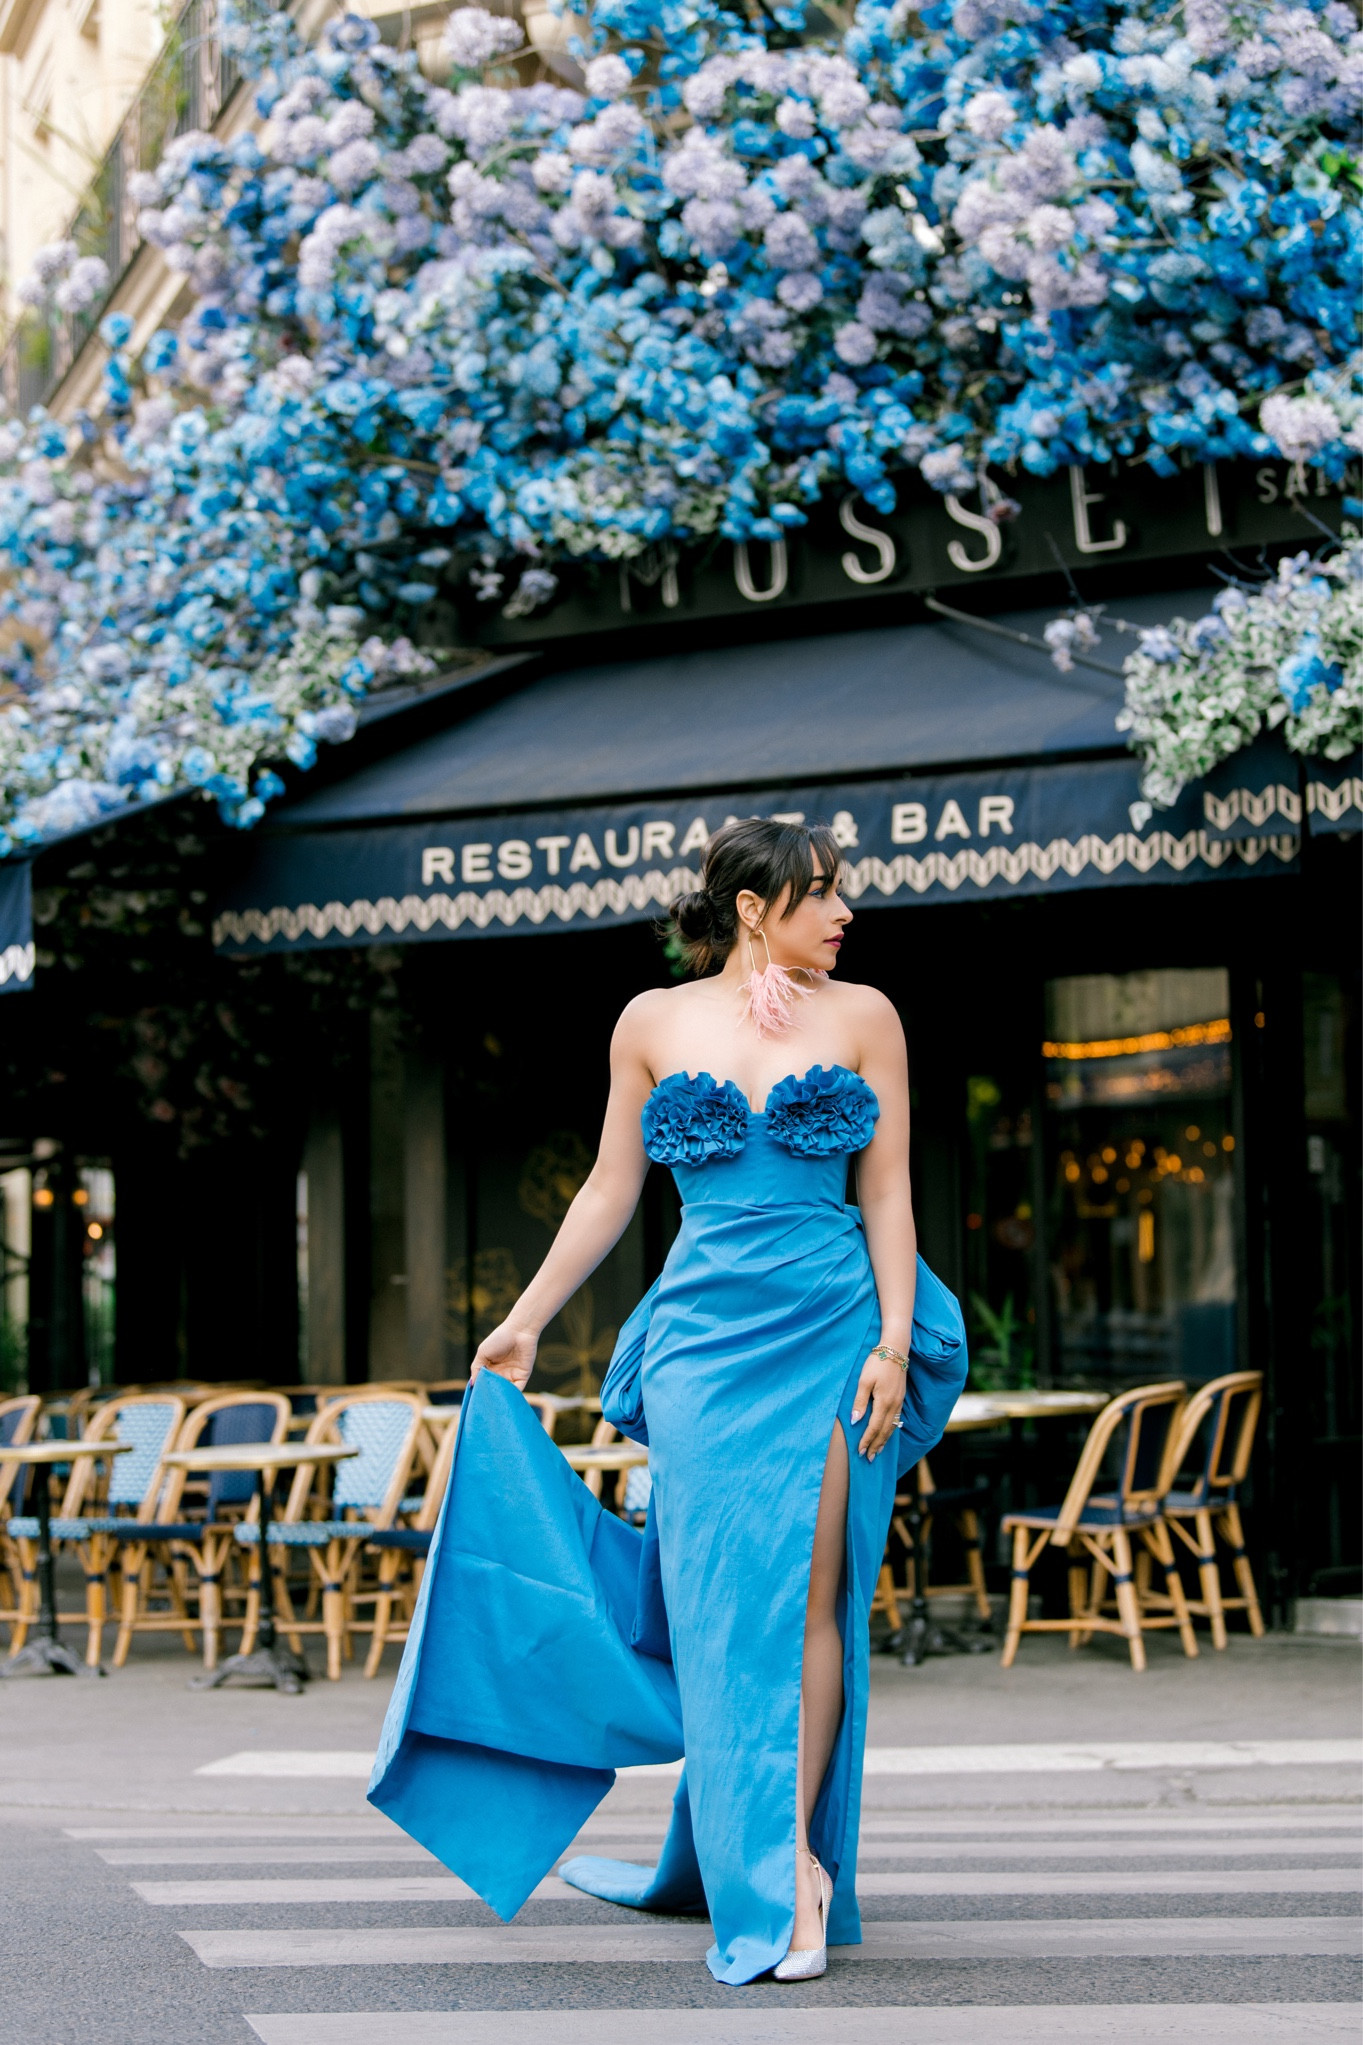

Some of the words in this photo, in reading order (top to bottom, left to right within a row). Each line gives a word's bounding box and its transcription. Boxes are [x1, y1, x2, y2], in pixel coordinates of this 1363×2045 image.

[422, 812, 805, 885] RESTAURA
[832, 810, 859, 848] &
[891, 796, 1015, 844] BAR
